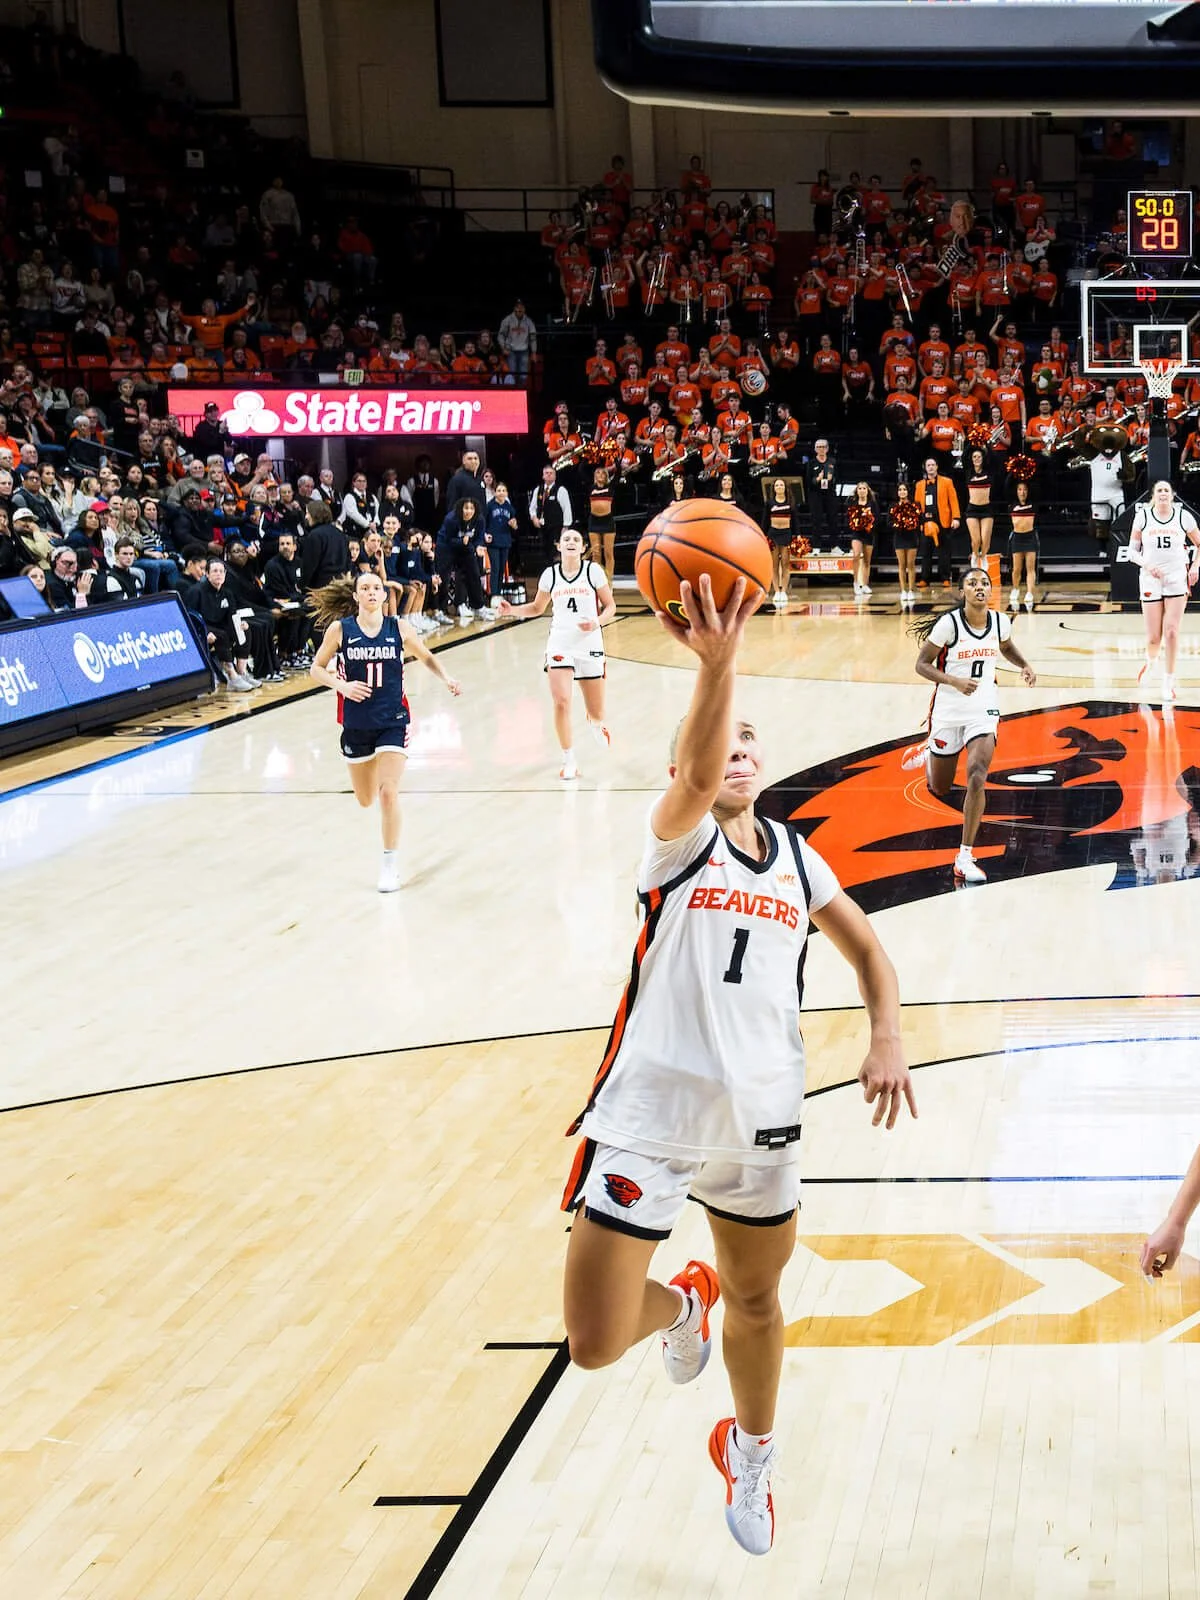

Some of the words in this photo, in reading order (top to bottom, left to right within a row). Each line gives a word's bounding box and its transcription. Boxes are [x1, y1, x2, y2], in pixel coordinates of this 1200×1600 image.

[1141, 218, 1178, 250] 28
[1155, 536, 1171, 549] 15
[567, 597, 578, 613] 4
[97, 629, 187, 671] PacificSource
[346, 646, 397, 660] GONZAGA
[366, 662, 384, 688] 11
[970, 660, 985, 678] 0
[687, 887, 800, 931] BEAVERS
[723, 928, 750, 984] 1
